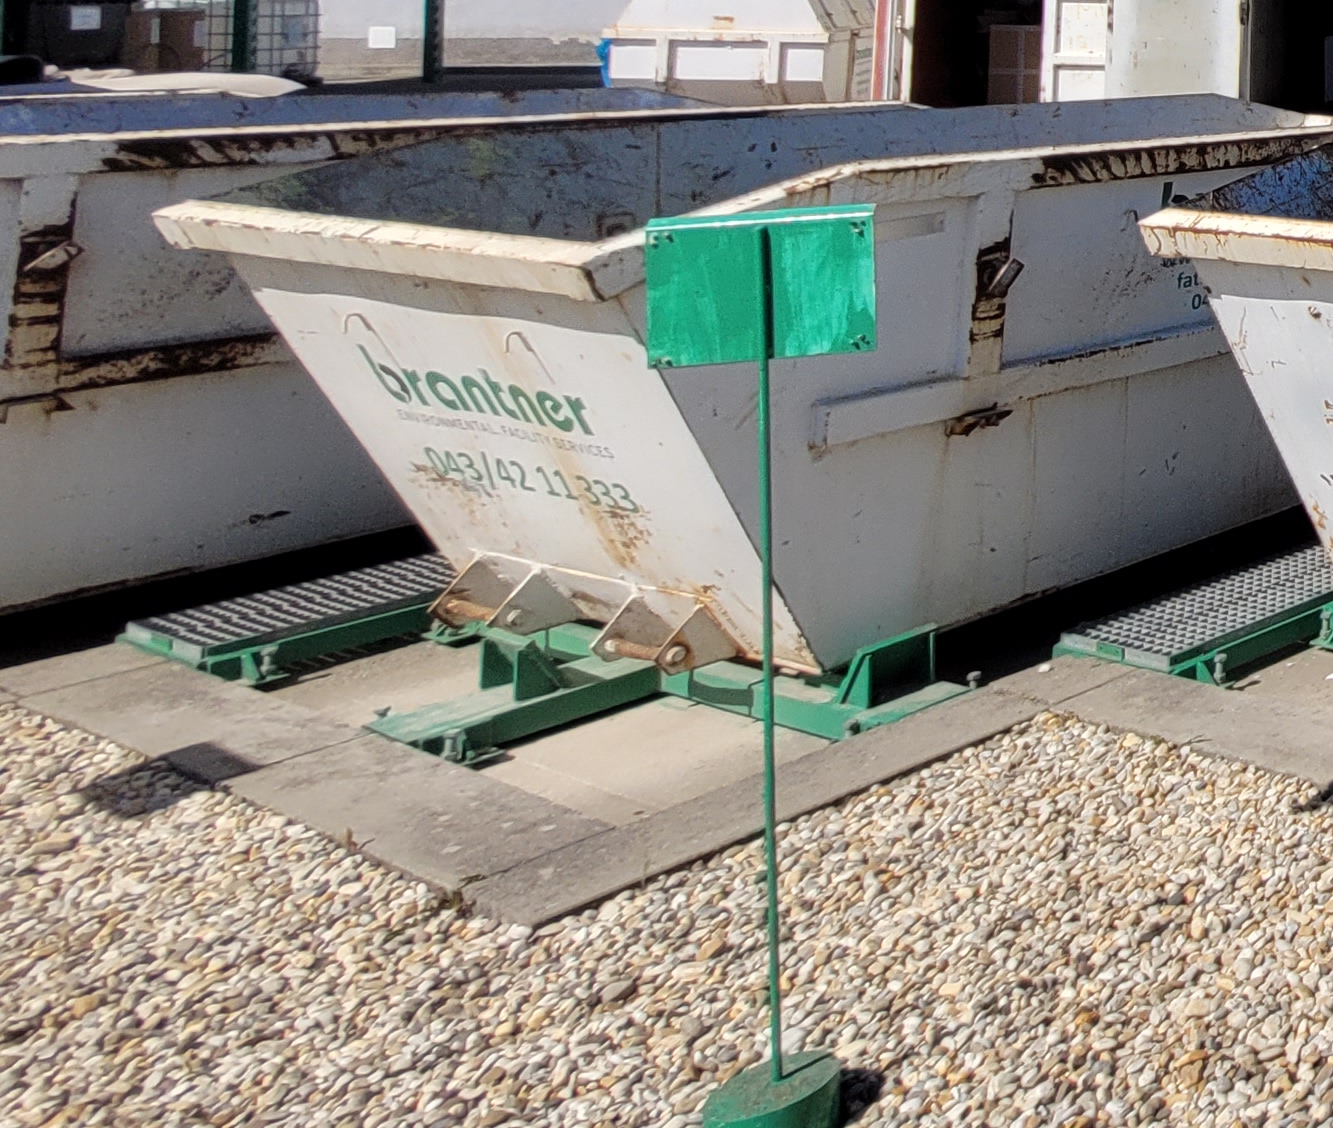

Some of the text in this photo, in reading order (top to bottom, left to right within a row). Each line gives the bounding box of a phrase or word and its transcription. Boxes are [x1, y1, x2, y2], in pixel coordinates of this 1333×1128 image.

[356, 344, 595, 435] brantner
[500, 425, 552, 447] FACILITY
[553, 436, 615, 459] SERVICES
[423, 447, 640, 513] 043/42 11 333
